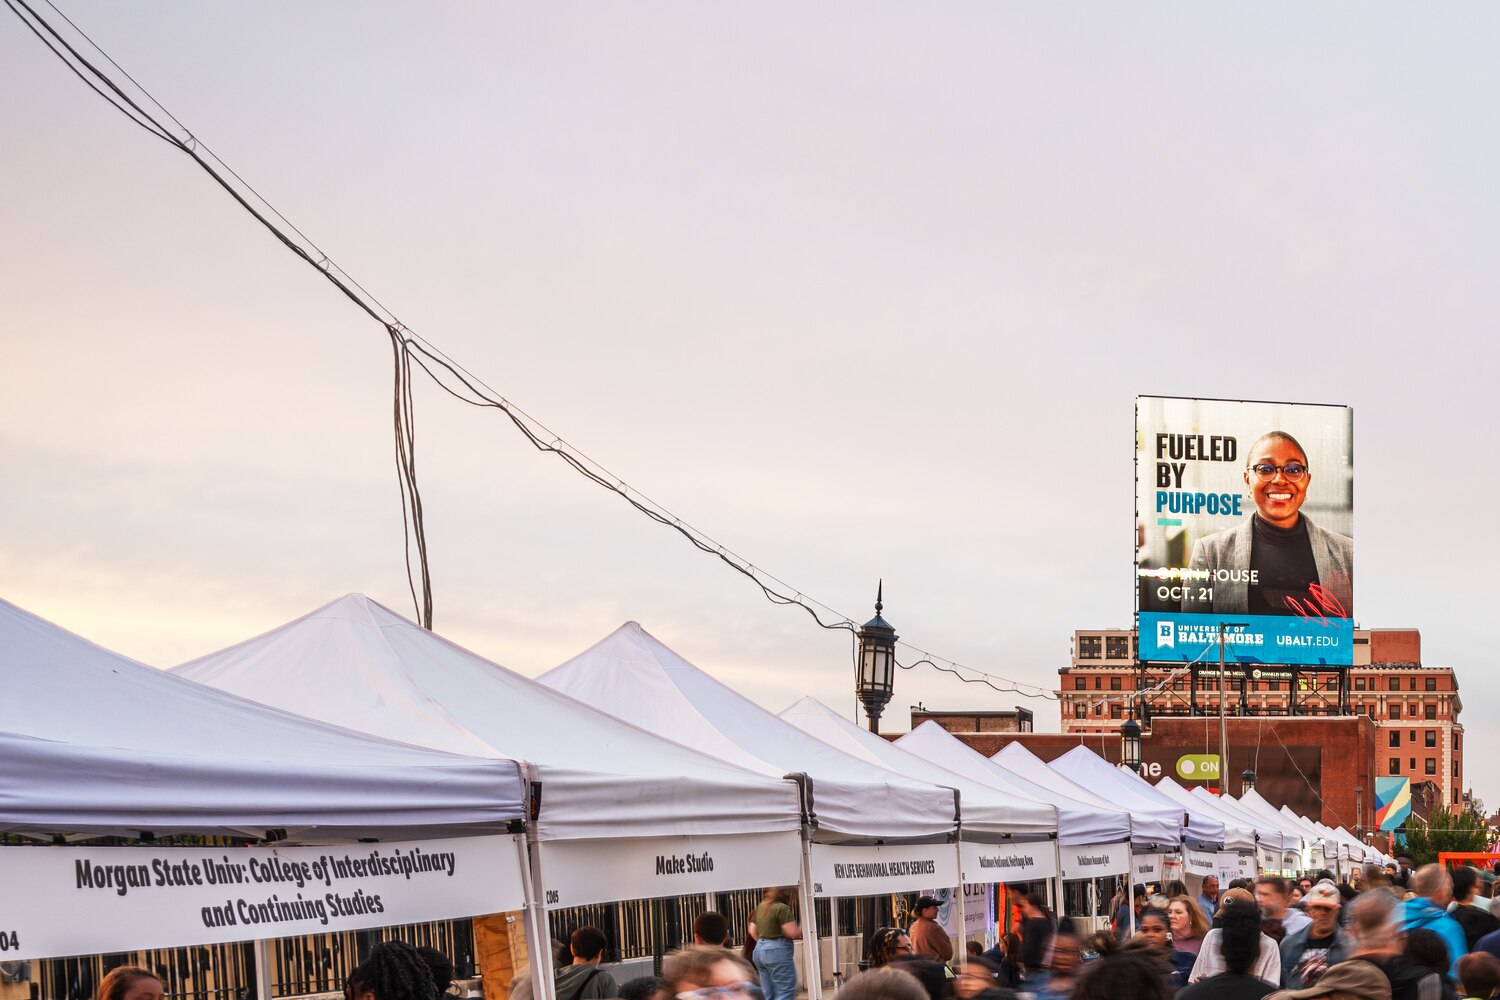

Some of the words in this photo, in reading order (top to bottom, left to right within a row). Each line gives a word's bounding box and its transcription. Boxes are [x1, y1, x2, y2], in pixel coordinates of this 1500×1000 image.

[1156, 433, 1237, 462] FUELED
[1156, 462, 1186, 489] BY
[1156, 491, 1243, 516] PURPOSE
[1157, 586, 1195, 600] OCT.
[1198, 587, 1213, 600] 21
[1178, 625, 1231, 633] UNIVERSIY
[1276, 635, 1339, 647] UBALT.EDU
[1200, 762, 1219, 772] ON
[75, 859, 151, 896] Morgan
[152, 858, 203, 887] State
[202, 855, 250, 885] Univ:
[249, 857, 313, 888] College
[311, 855, 331, 886] of
[329, 847, 456, 879] Interdisciplinary
[655, 855, 685, 876] Make
[686, 851, 714, 873] Studio
[833, 863, 845, 879] NEW
[844, 863, 856, 878] LIFE
[855, 862, 889, 878] BEHAVIORAL
[888, 861, 910, 877] HEALTH
[910, 860, 936, 875] SERVICES
[201, 900, 237, 928] and
[236, 893, 329, 926] Continuing
[325, 889, 385, 917] Studies
